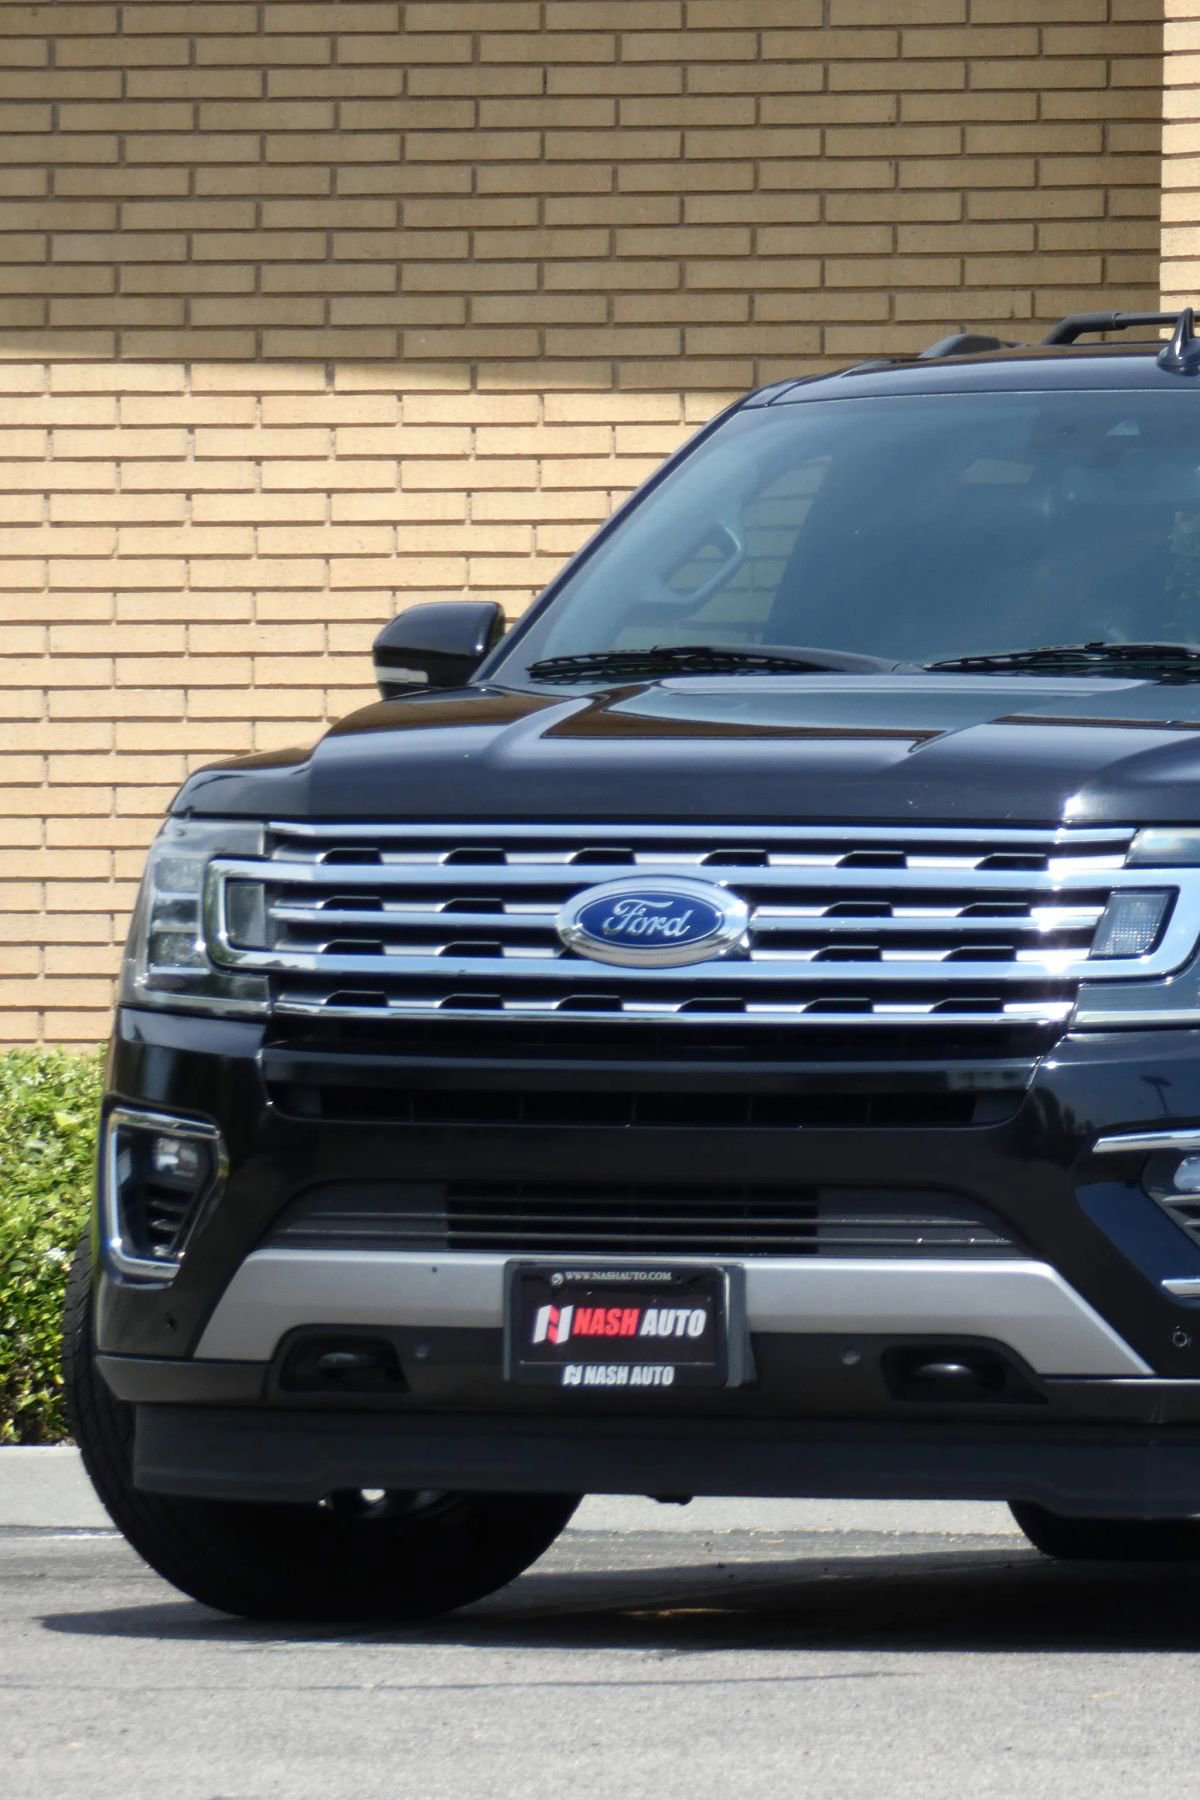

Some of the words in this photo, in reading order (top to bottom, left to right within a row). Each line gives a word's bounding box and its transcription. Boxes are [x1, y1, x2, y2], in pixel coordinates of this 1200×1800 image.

[603, 899, 693, 936] Ford
[565, 1271, 672, 1280] WWW.NASHAUTO.COM
[573, 1307, 640, 1336] NASH
[640, 1308, 707, 1336] AUTO
[584, 1365, 629, 1384] NASH
[629, 1365, 675, 1385] AUTO
